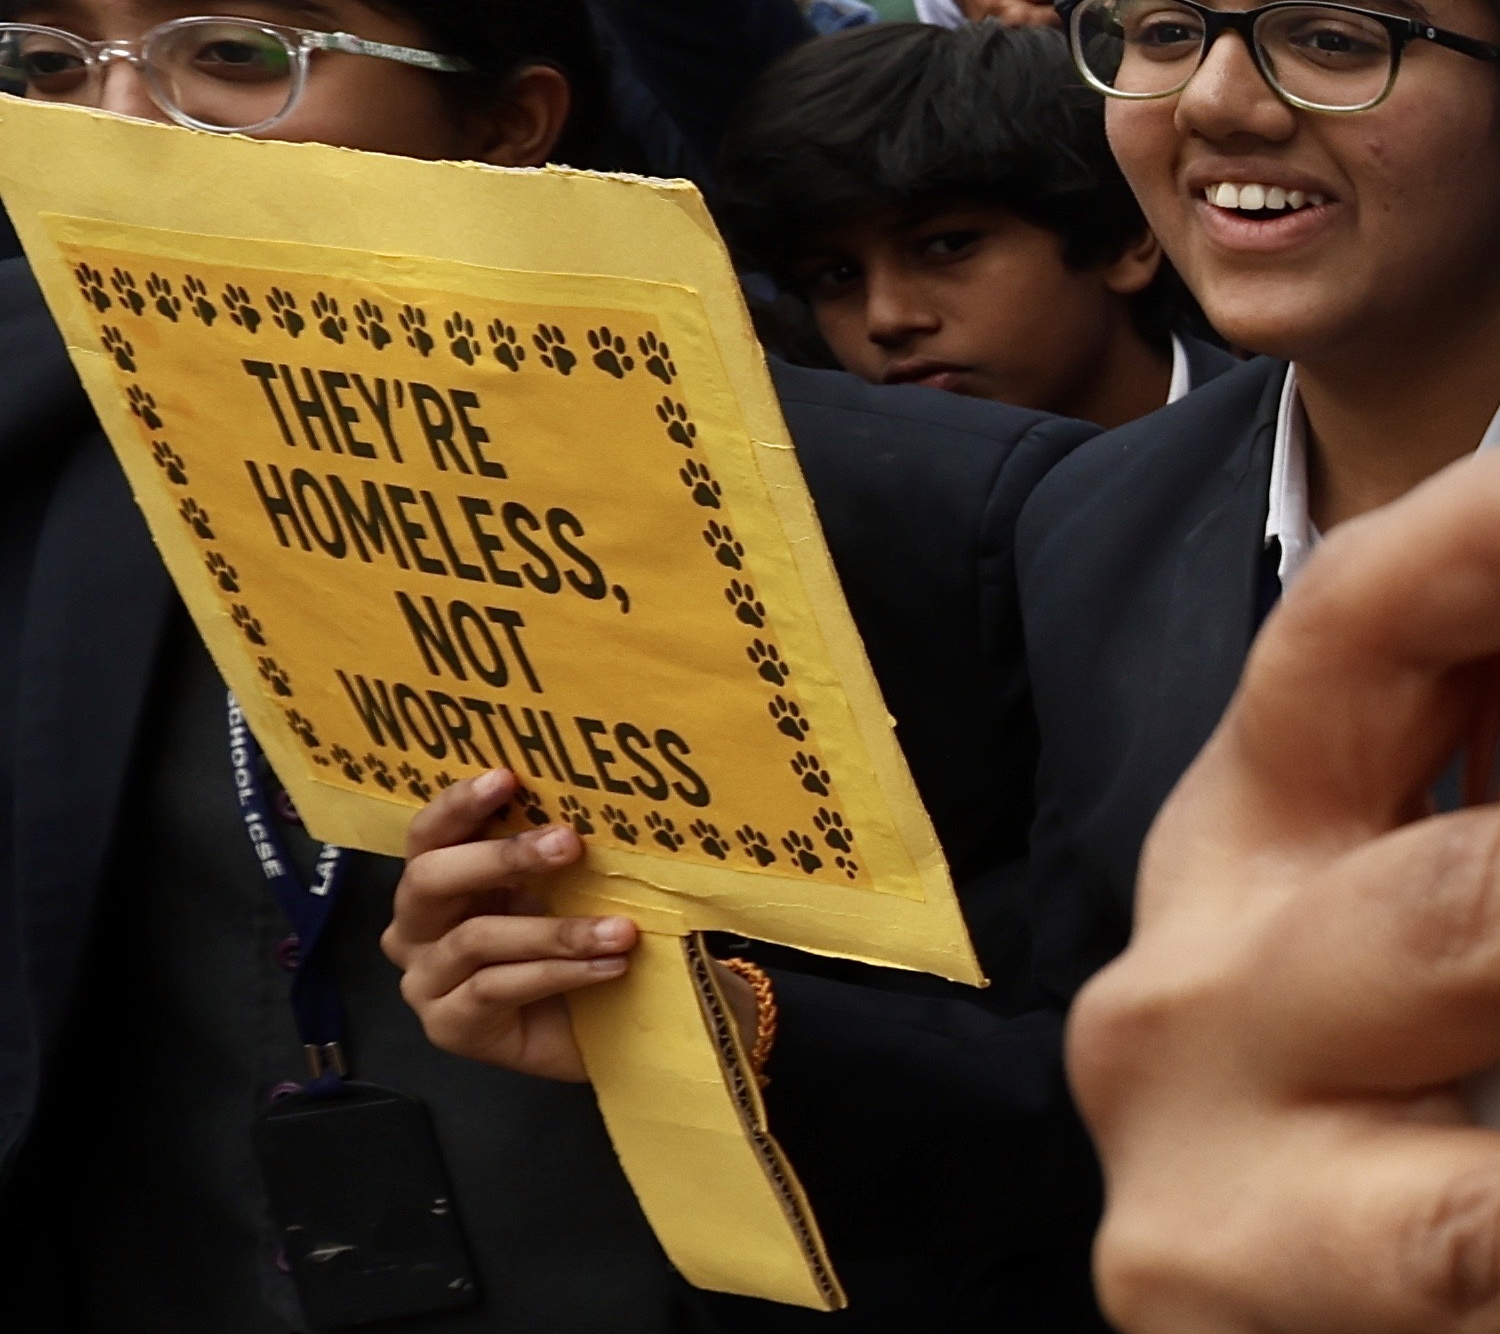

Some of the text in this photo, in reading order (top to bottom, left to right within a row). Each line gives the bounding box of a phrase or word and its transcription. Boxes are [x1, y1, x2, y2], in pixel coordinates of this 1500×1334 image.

[244, 358, 508, 478] THEY'RE
[246, 460, 632, 615] HOMELESS,
[396, 590, 545, 694] NOT
[335, 668, 713, 810] WORTHLESS
[244, 812, 287, 880] ICSE
